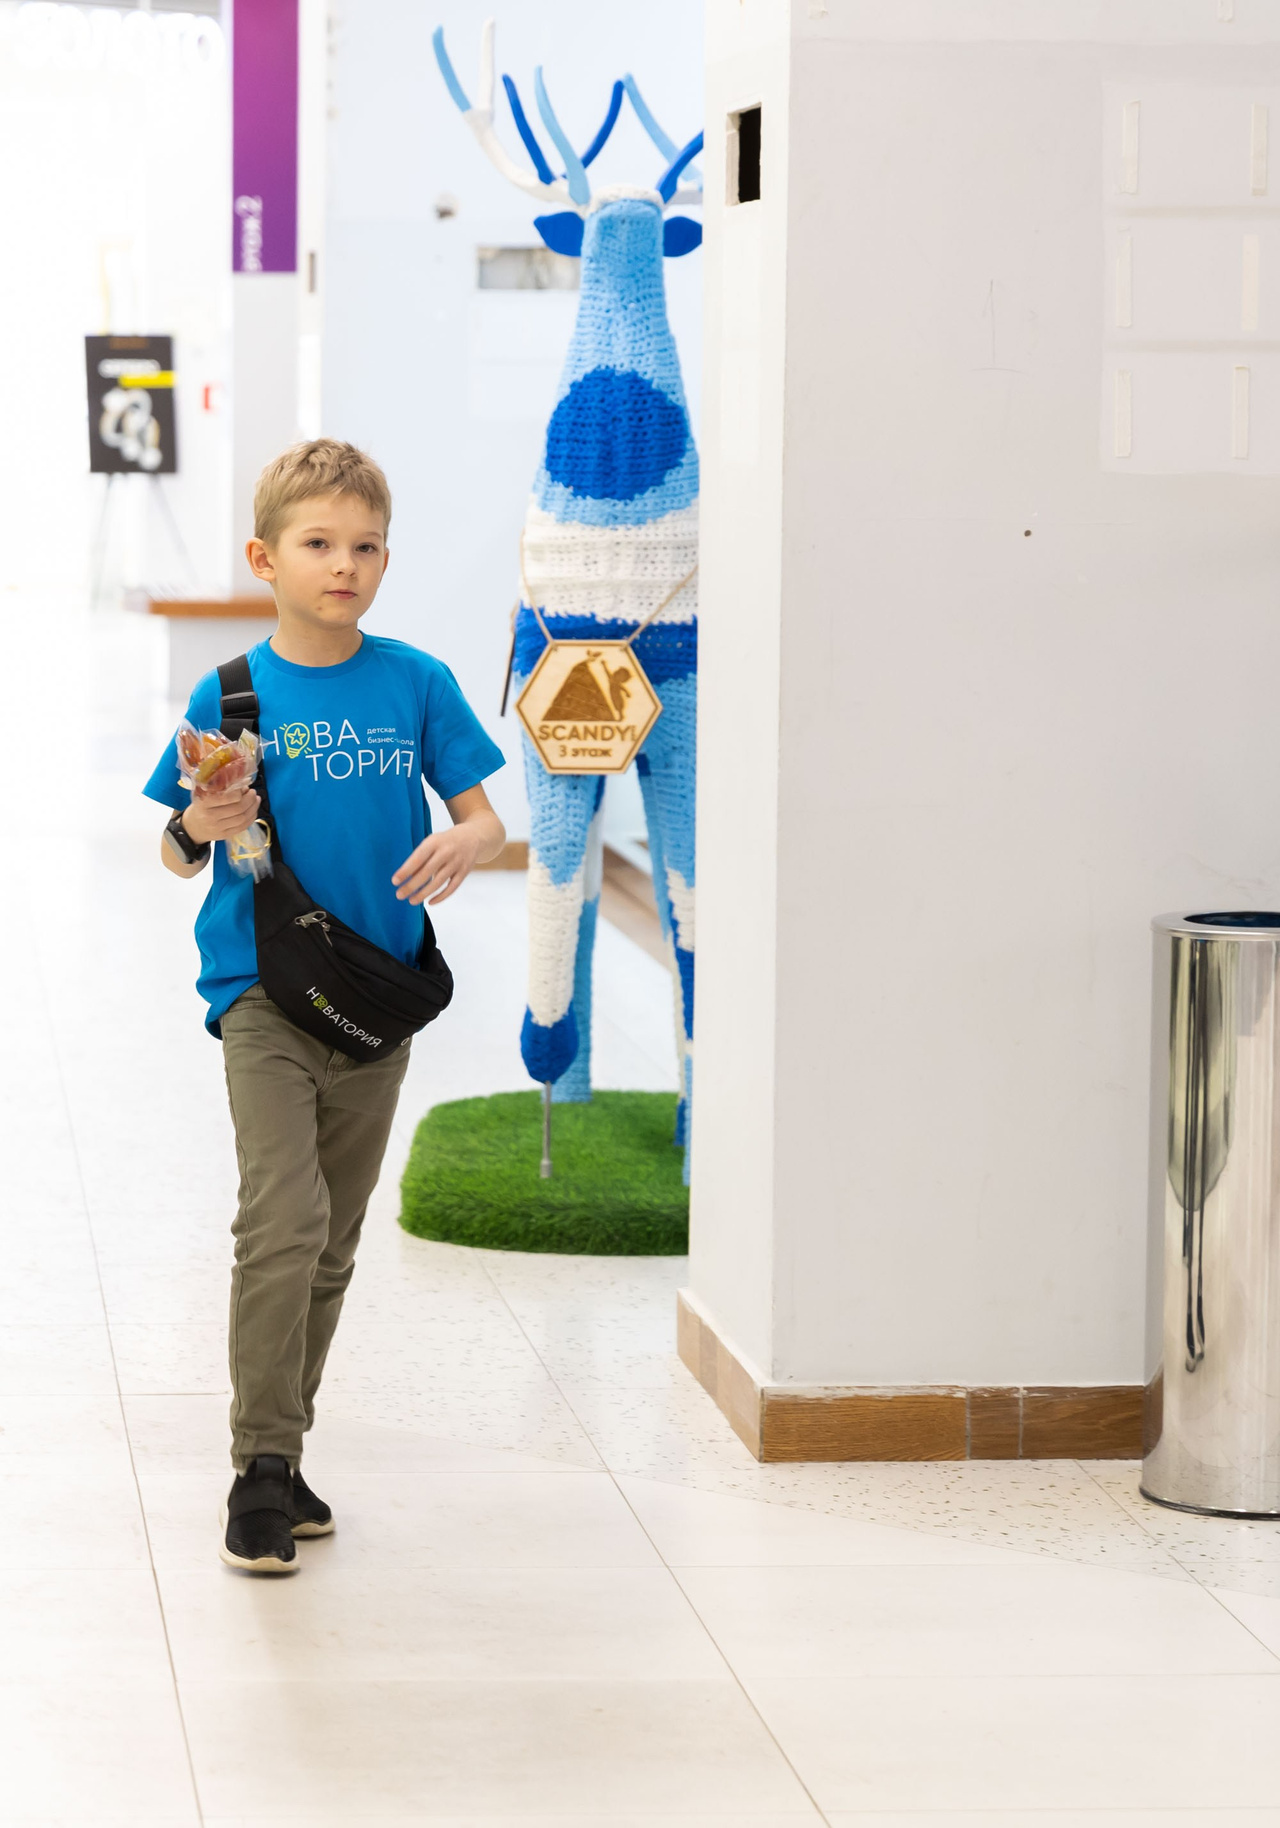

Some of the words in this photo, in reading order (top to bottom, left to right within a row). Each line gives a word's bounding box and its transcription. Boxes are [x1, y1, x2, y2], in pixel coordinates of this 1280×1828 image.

[367, 736, 415, 746] бизнес-ола
[559, 745, 568, 757] 3
[571, 748, 612, 758] этаж
